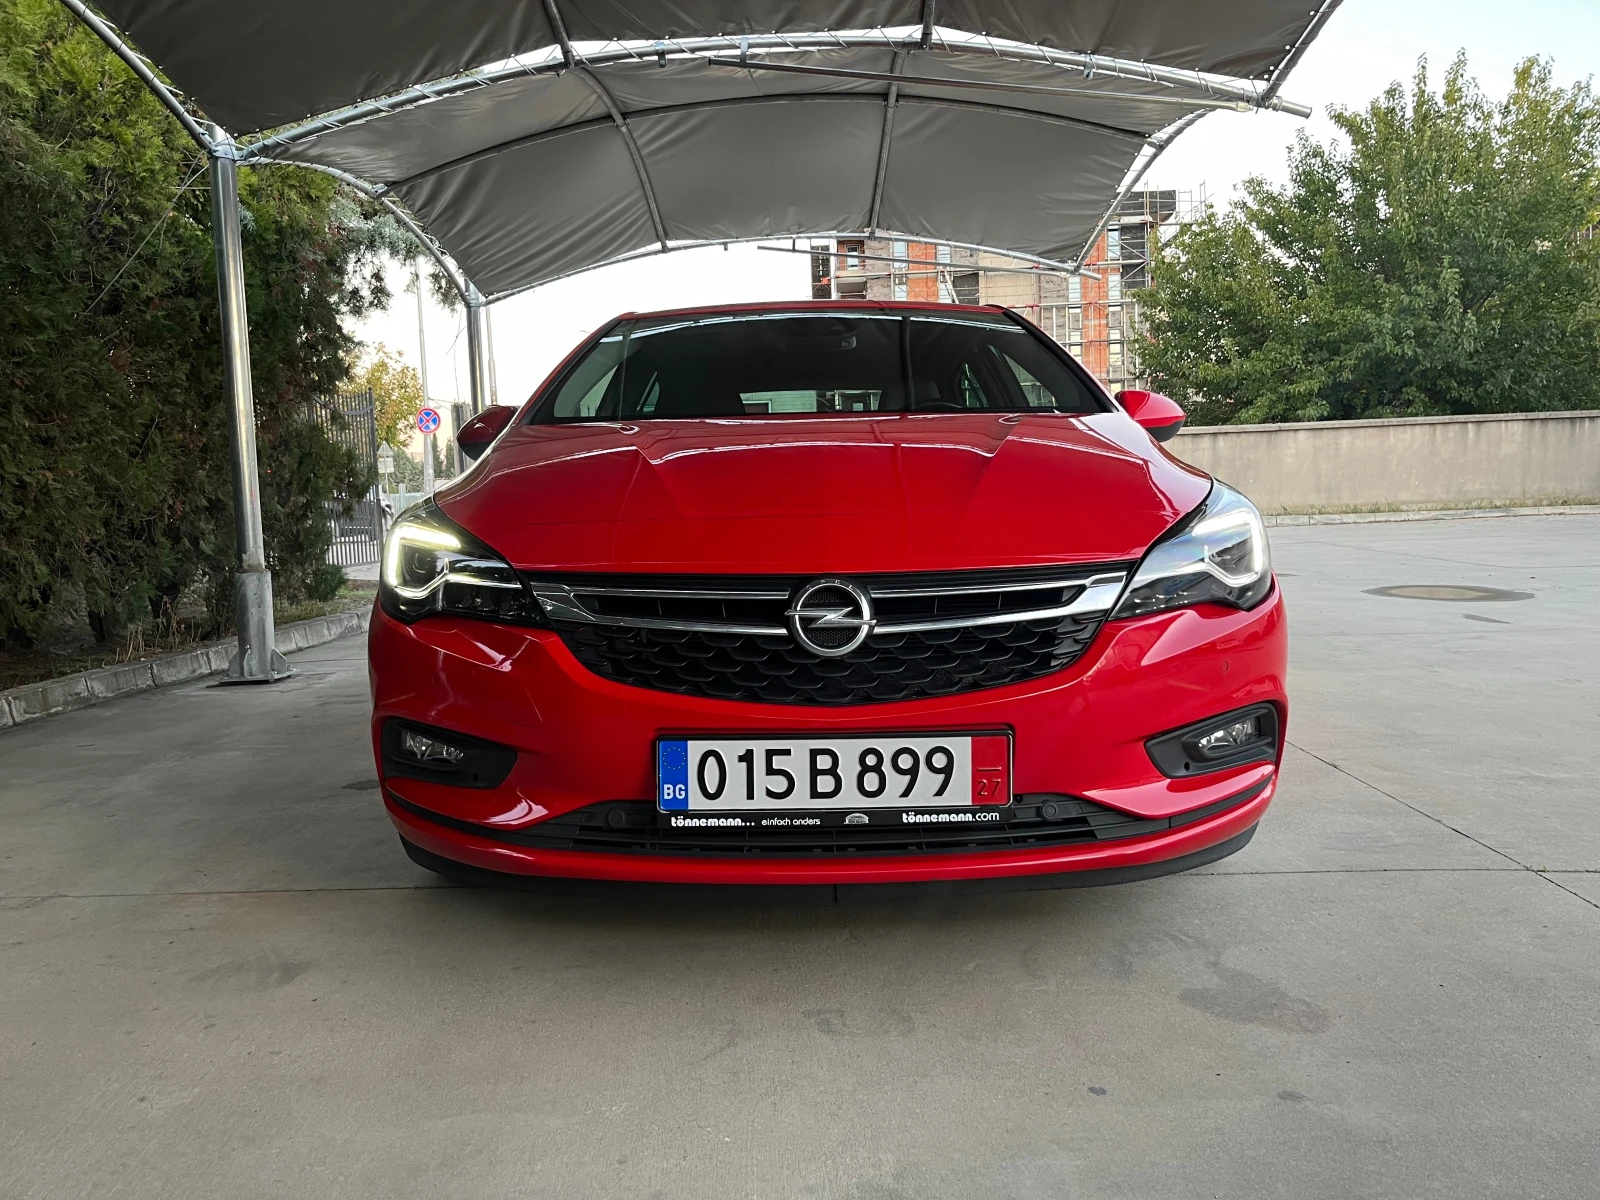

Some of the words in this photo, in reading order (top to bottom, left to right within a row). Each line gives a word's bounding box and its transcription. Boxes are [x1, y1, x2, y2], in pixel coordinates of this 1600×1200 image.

[697, 748, 796, 801] 015
[808, 748, 843, 800] B
[856, 745, 955, 799] 899
[663, 784, 686, 800] BG
[977, 778, 1002, 797] 27
[761, 817, 791, 826] einfach
[792, 817, 821, 825] anders
[902, 811, 1000, 823] tönnemann.com
